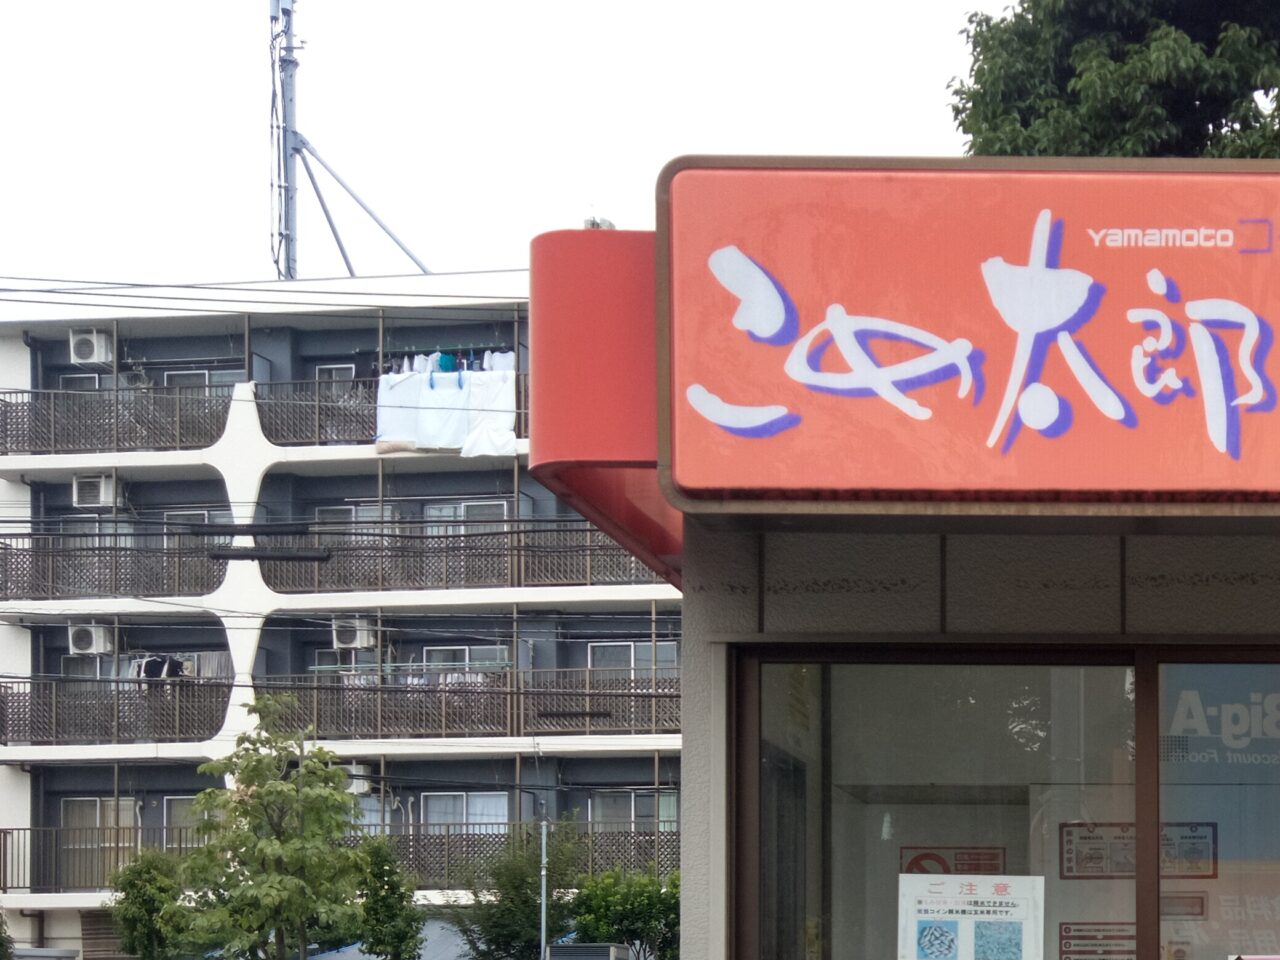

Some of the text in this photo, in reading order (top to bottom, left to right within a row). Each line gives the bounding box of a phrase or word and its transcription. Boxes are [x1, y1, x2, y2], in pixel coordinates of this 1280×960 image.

[687, 209, 1275, 460] こめ太郎
[927, 881, 1012, 896] ご注意
